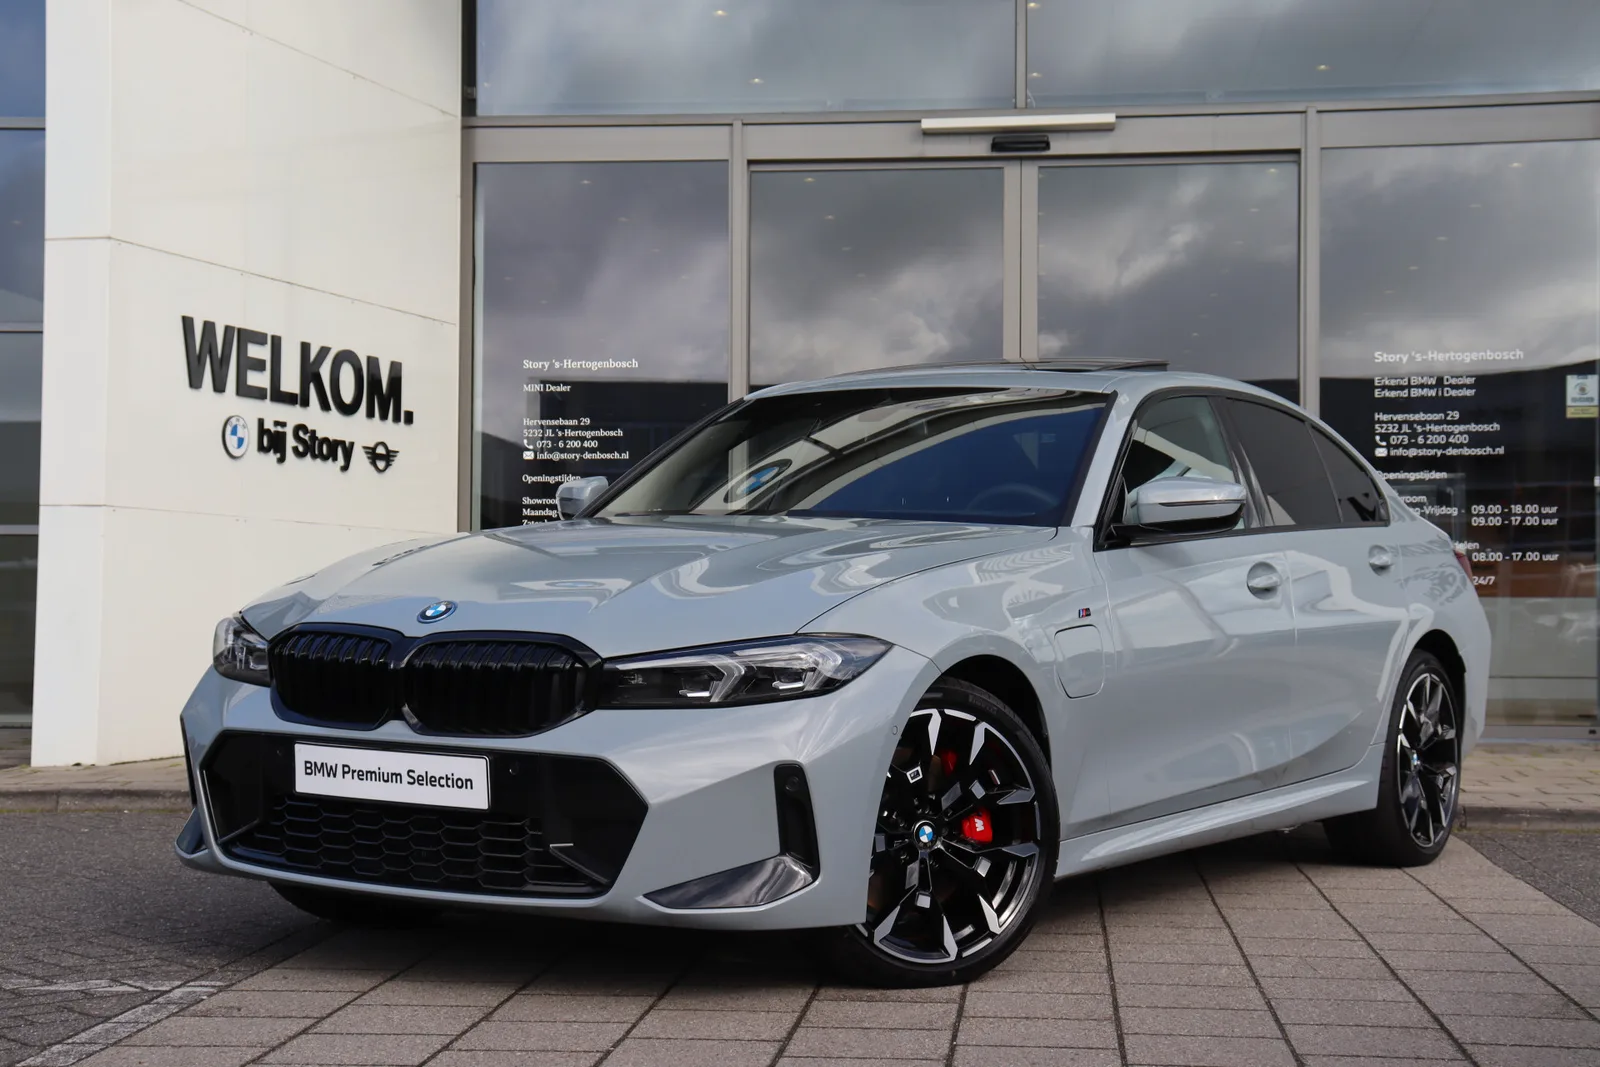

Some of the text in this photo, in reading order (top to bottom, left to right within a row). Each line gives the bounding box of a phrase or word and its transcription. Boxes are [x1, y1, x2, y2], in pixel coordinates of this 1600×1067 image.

[1374, 349, 1524, 364] Story 's-Hertogenbosch
[181, 315, 414, 425] WELKOM.
[523, 359, 639, 371] Story 's-Hertogenbosch
[1374, 375, 1476, 386] Erkend BMW Dealer
[523, 384, 571, 392] MINI Dealer
[1374, 388, 1408, 398] Erkend
[1410, 388, 1436, 397] BMW
[1443, 387, 1476, 397] Dealer
[1374, 411, 1460, 421] Hervensebaan 29
[523, 418, 578, 426] Hervensebaan
[523, 428, 623, 438] 5232 JL 's-Hertogenbosch
[1375, 422, 1500, 434] 5232 JL 's-Hertogenbosch
[257, 418, 355, 472] bij Story
[536, 440, 552, 448] 073
[558, 440, 564, 448] 6
[566, 440, 581, 448] 200
[582, 440, 598, 448] 400
[1390, 436, 1409, 445] 073
[1417, 435, 1425, 444] 6
[1426, 435, 1447, 444] 200
[1448, 434, 1469, 443] 400
[537, 451, 629, 461] info@story-denbosch.nl
[1390, 446, 1505, 457] info@story-denbosch.nl
[1471, 505, 1502, 514] 09.00
[1510, 504, 1539, 514] 18.00
[1541, 506, 1558, 514] uur
[1471, 517, 1502, 526] 09.00
[1541, 518, 1558, 526] uur
[1472, 552, 1502, 561] 08.00
[1542, 553, 1559, 561] uur
[304, 760, 473, 790] BMW Premium Selection
